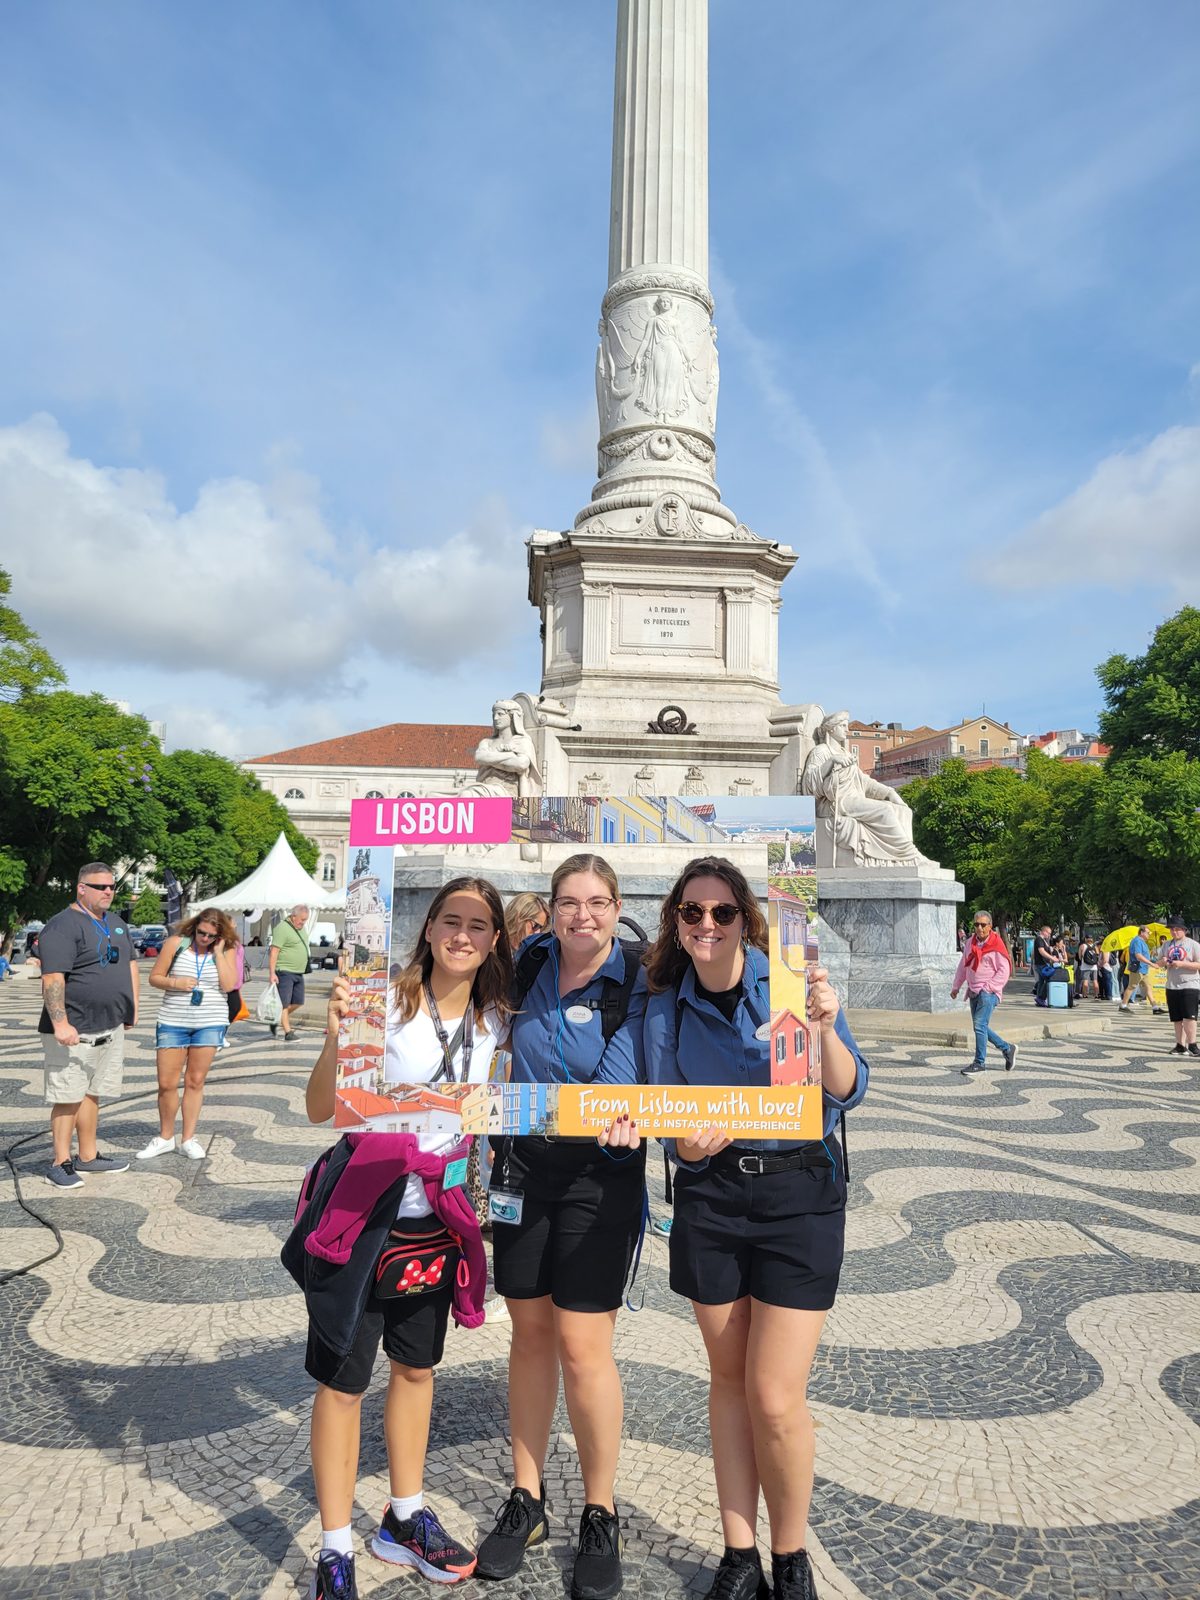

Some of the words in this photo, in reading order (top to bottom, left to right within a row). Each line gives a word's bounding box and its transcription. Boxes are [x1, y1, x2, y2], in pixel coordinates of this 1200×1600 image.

[661, 606, 678, 614] PEDRO
[375, 801, 475, 835] LISBON
[578, 1089, 630, 1117] From
[638, 1090, 699, 1116] Lisbon
[707, 1091, 751, 1116] with
[758, 1094, 804, 1118] love!
[590, 1118, 611, 1127] THE
[653, 1119, 661, 1128] &
[663, 1119, 729, 1130] INSTAGRAM
[731, 1120, 801, 1131] EXPERIENCE
